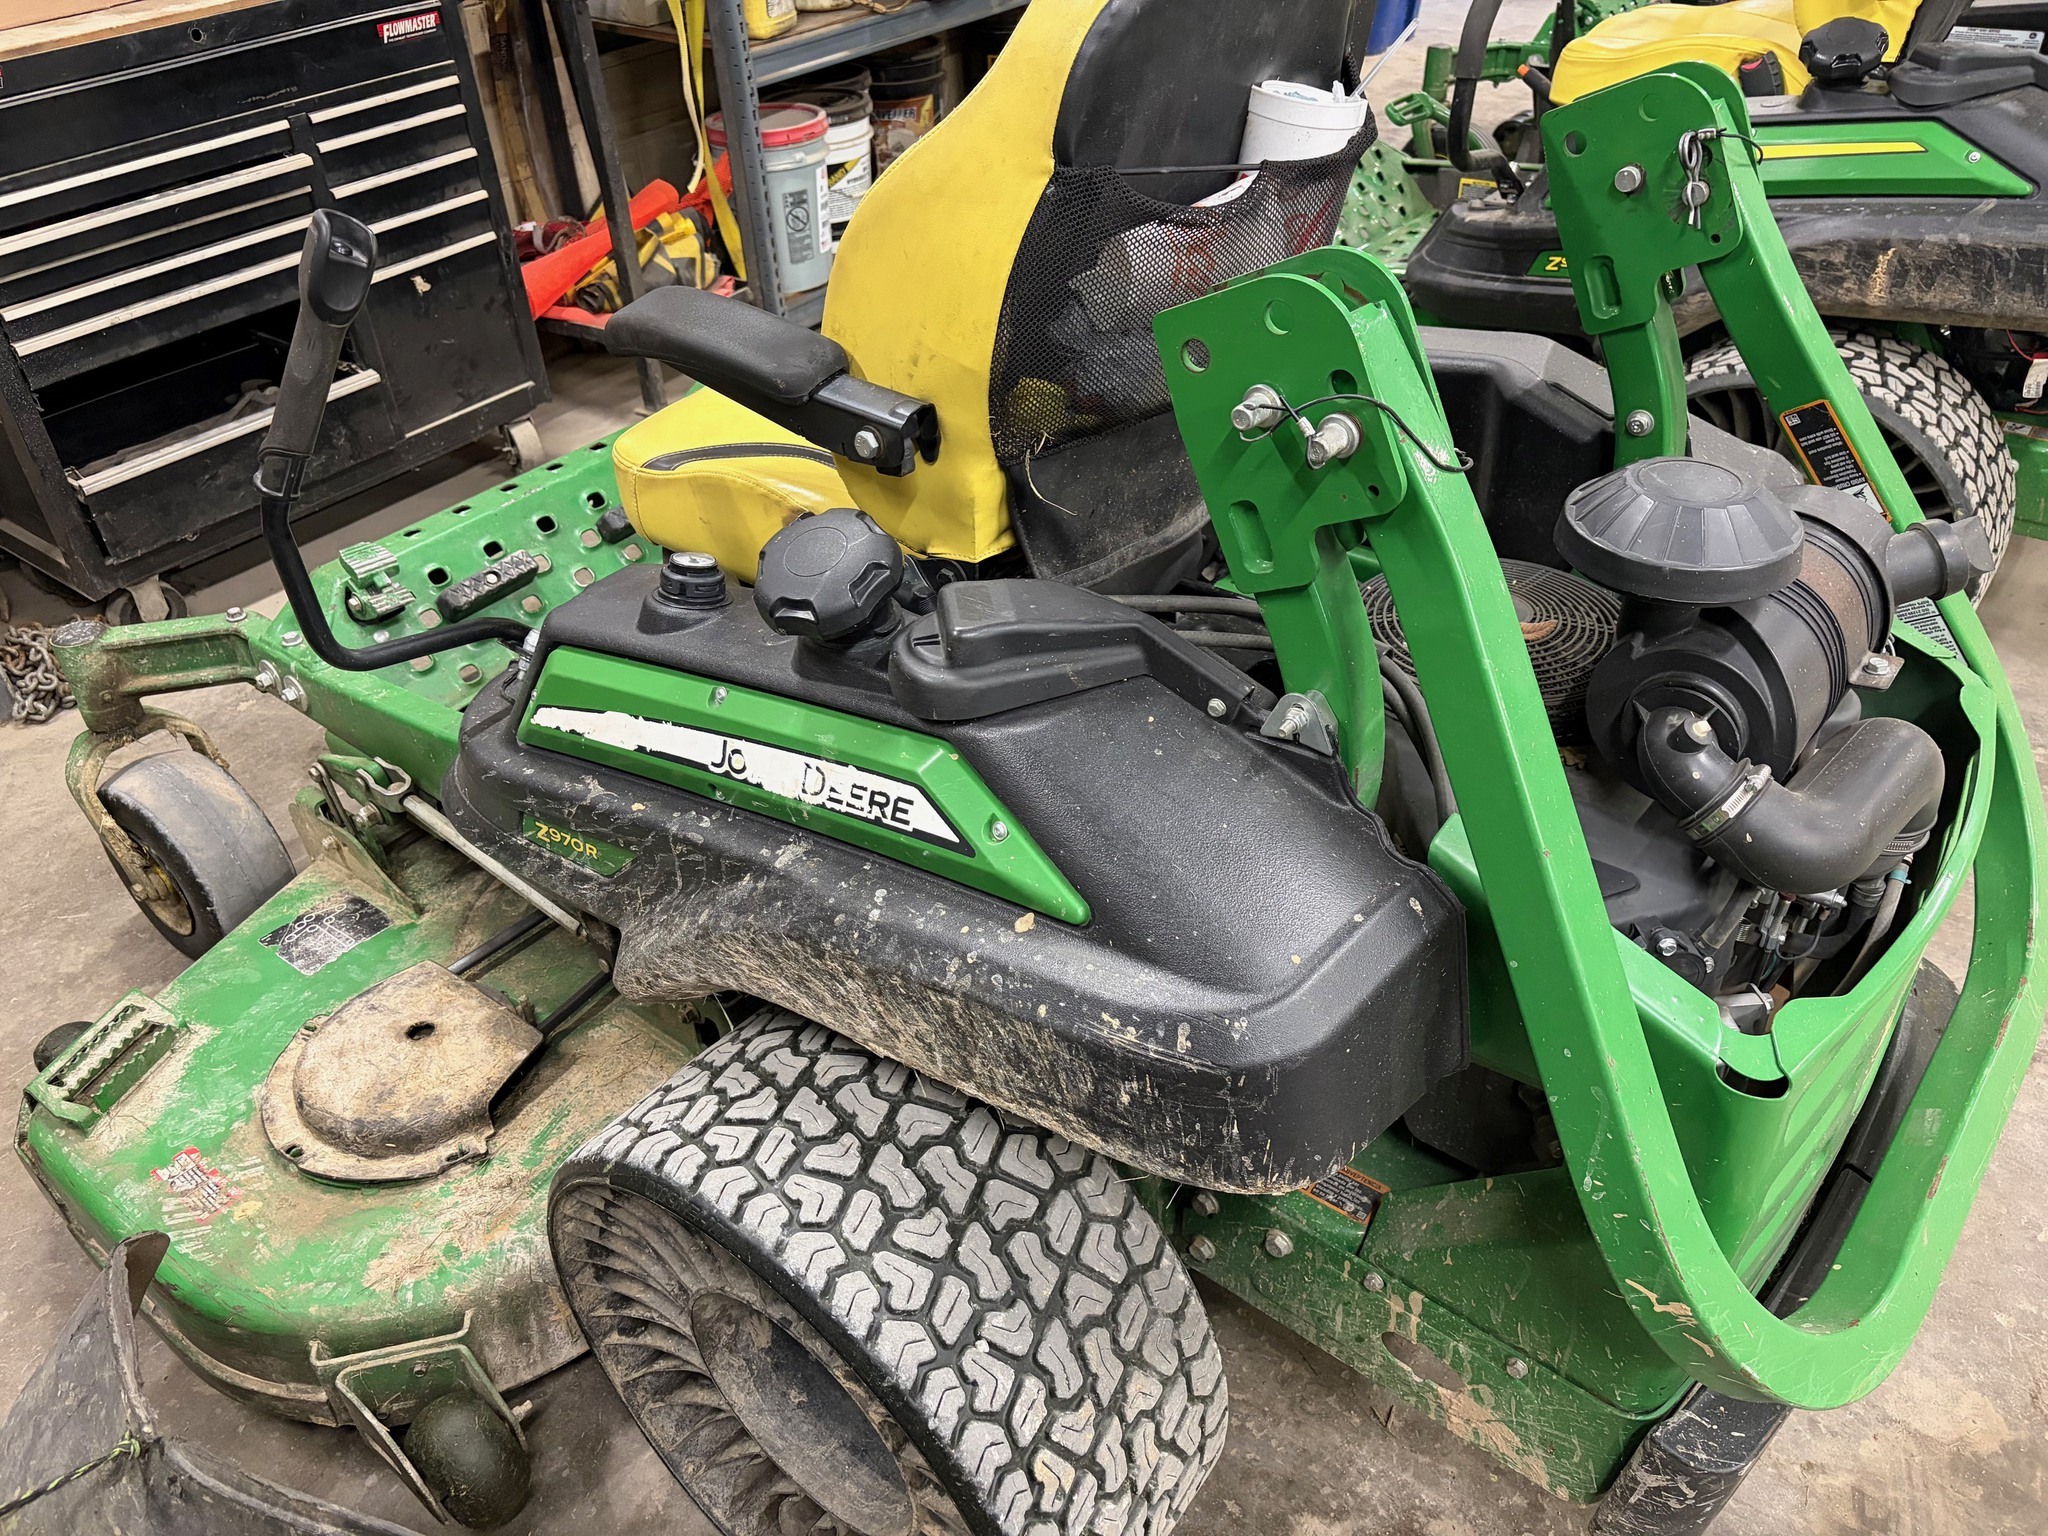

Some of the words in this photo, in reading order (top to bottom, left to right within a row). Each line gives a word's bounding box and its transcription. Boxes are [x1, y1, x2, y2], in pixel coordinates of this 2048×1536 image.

[383, 13, 437, 44] FLOWMASTER
[1851, 477, 1865, 485] AVOID
[534, 821, 599, 861] Z970R
